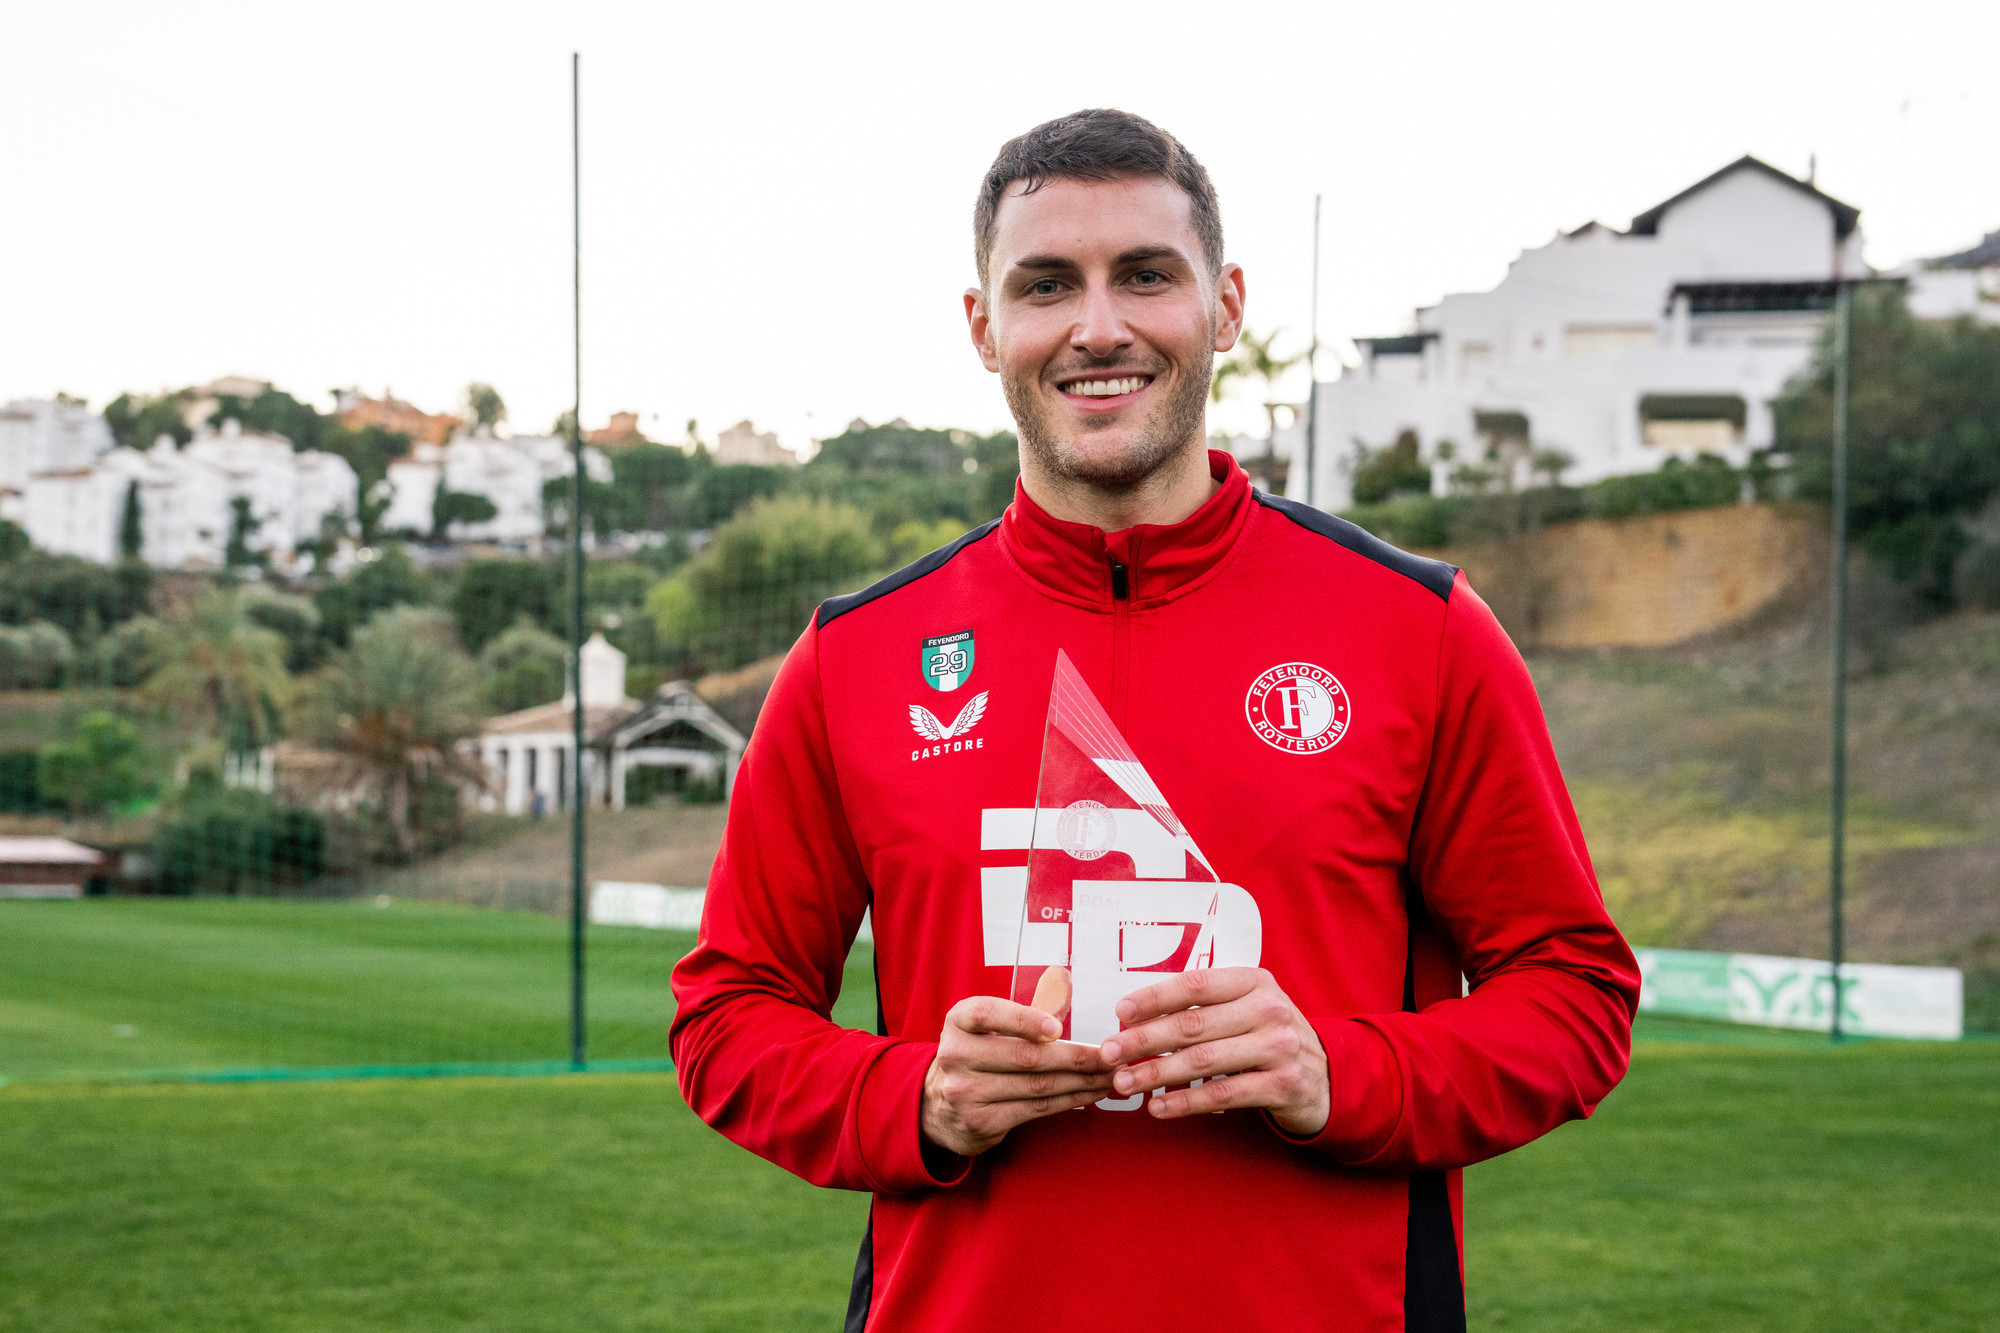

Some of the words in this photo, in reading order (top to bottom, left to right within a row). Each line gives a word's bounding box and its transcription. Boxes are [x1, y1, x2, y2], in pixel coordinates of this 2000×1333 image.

[928, 632, 970, 646] FEYENOORD
[929, 649, 968, 677] 29
[1252, 665, 1340, 697] FEYENOORD
[1255, 719, 1345, 751] ROTTERDAM
[911, 738, 984, 762] CASTORE
[1040, 906, 1064, 921] OF
